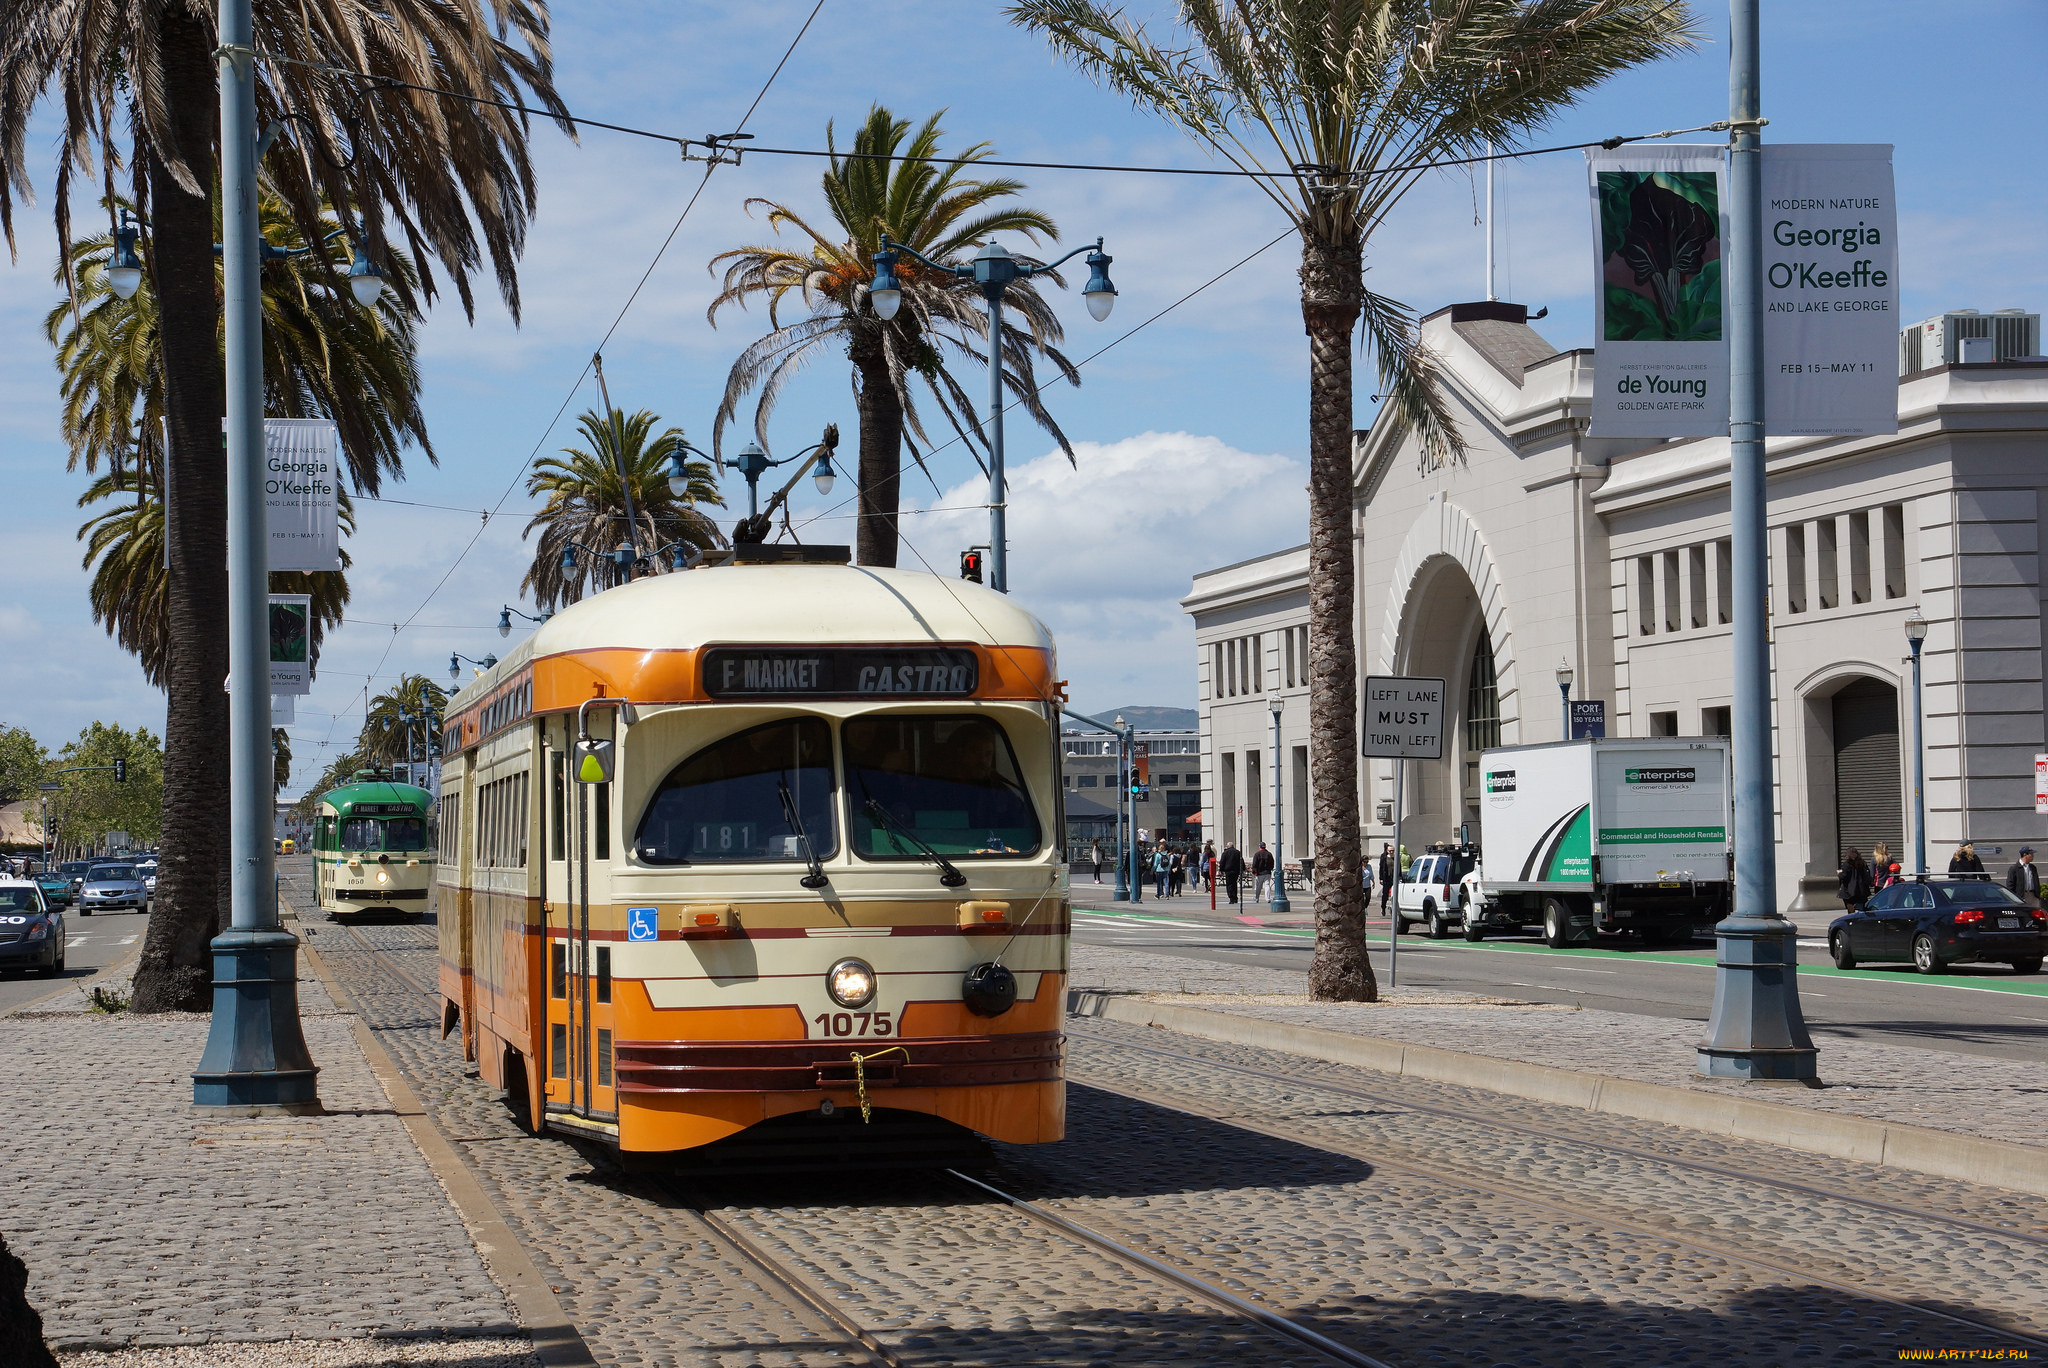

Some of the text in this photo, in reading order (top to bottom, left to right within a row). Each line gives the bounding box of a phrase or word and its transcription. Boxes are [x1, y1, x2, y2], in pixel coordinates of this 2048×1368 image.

[1771, 198, 1880, 210] MODERN NATURE
[1773, 220, 1881, 253] Georgia
[1768, 259, 1888, 289] O'Keeffe
[1768, 300, 1889, 313] AND LAKE GEORGE
[1780, 364, 1803, 374] FEB
[1861, 362, 1874, 373] 11
[1617, 375, 1707, 398] de Young
[1617, 402, 1705, 411] GOLDEN GATE PARK
[268, 458, 328, 476] Georgia
[265, 480, 331, 494] O'Keeffe
[277, 673, 301, 681] Young
[722, 659, 968, 692] F MARKET CASTRO
[1372, 690, 1438, 702] LEFT LANE
[1577, 704, 1599, 713] PORT
[1378, 711, 1430, 725] MUST
[1370, 734, 1437, 746] TURN LEFT
[1487, 774, 1516, 789] enterprise
[1627, 770, 1695, 781] enterprise
[1601, 832, 1643, 840] Commercial
[1658, 831, 1696, 839] Household
[814, 1012, 892, 1037] 1075
